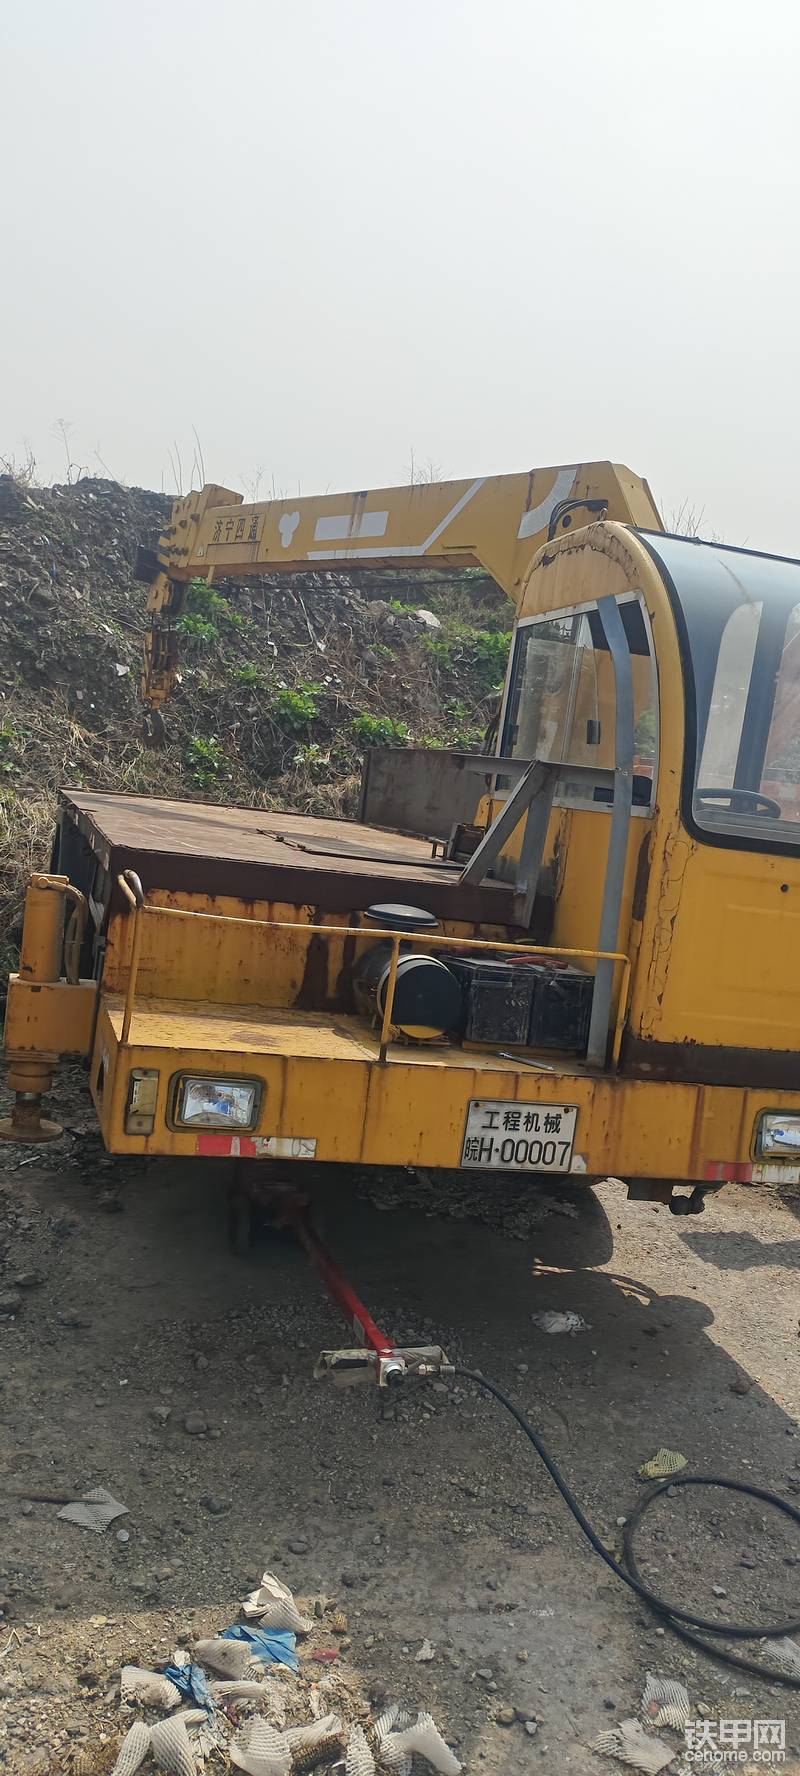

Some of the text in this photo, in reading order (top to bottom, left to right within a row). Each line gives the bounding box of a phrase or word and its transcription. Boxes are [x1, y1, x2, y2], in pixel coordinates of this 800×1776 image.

[212, 516, 260, 542] 济宁四通
[481, 1110, 562, 1134] 工程机械
